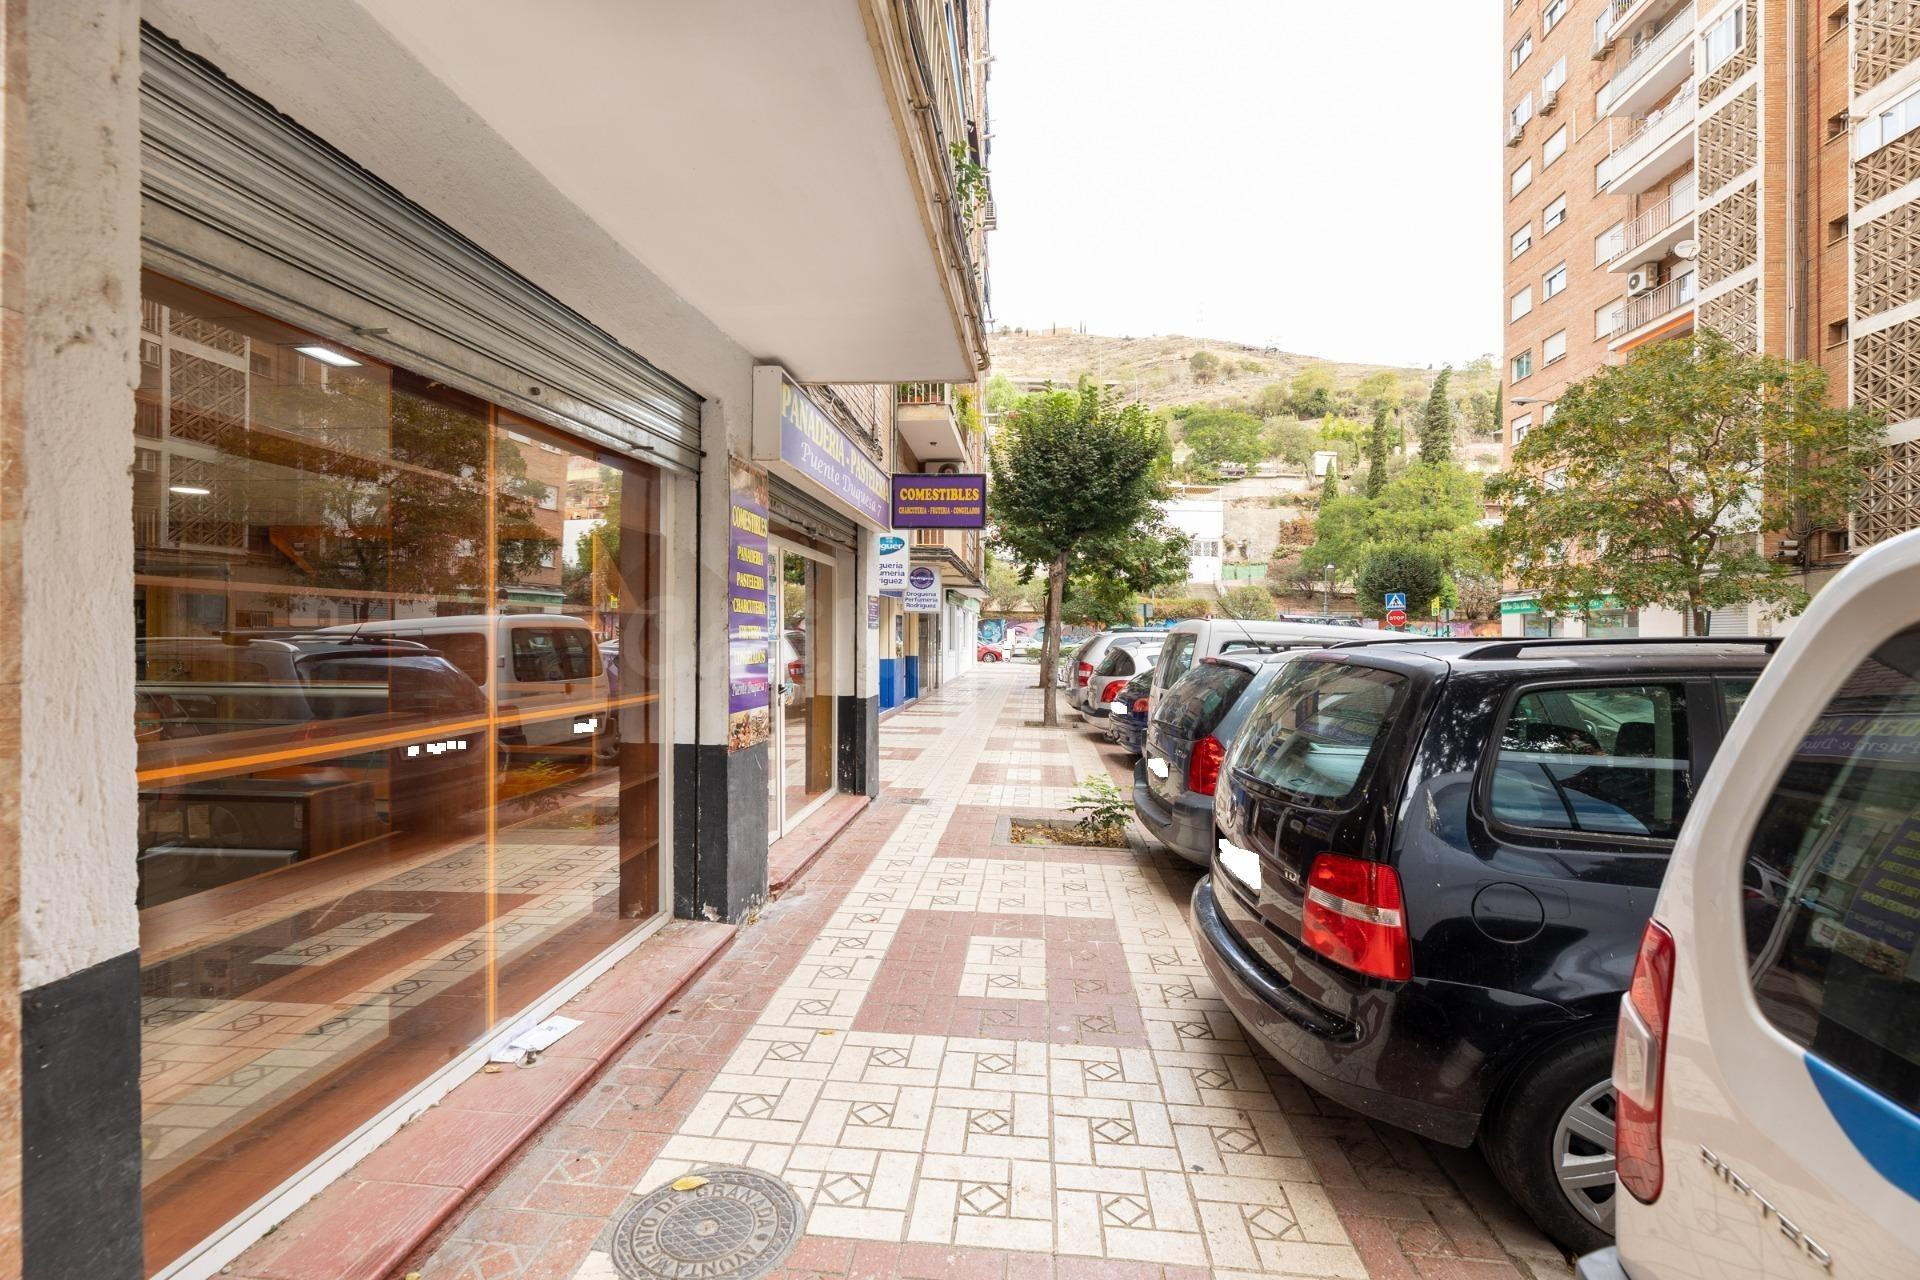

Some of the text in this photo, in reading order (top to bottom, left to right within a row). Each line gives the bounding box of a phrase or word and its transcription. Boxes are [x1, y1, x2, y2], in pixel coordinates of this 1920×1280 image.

[801, 441, 840, 486] Puente
[842, 474, 876, 511] Duquesa
[900, 487, 980, 501] COMESTIBLES
[732, 505, 768, 538] COMESTIBLES
[655, 1193, 687, 1215] DE
[695, 1182, 775, 1229] GRANADA
